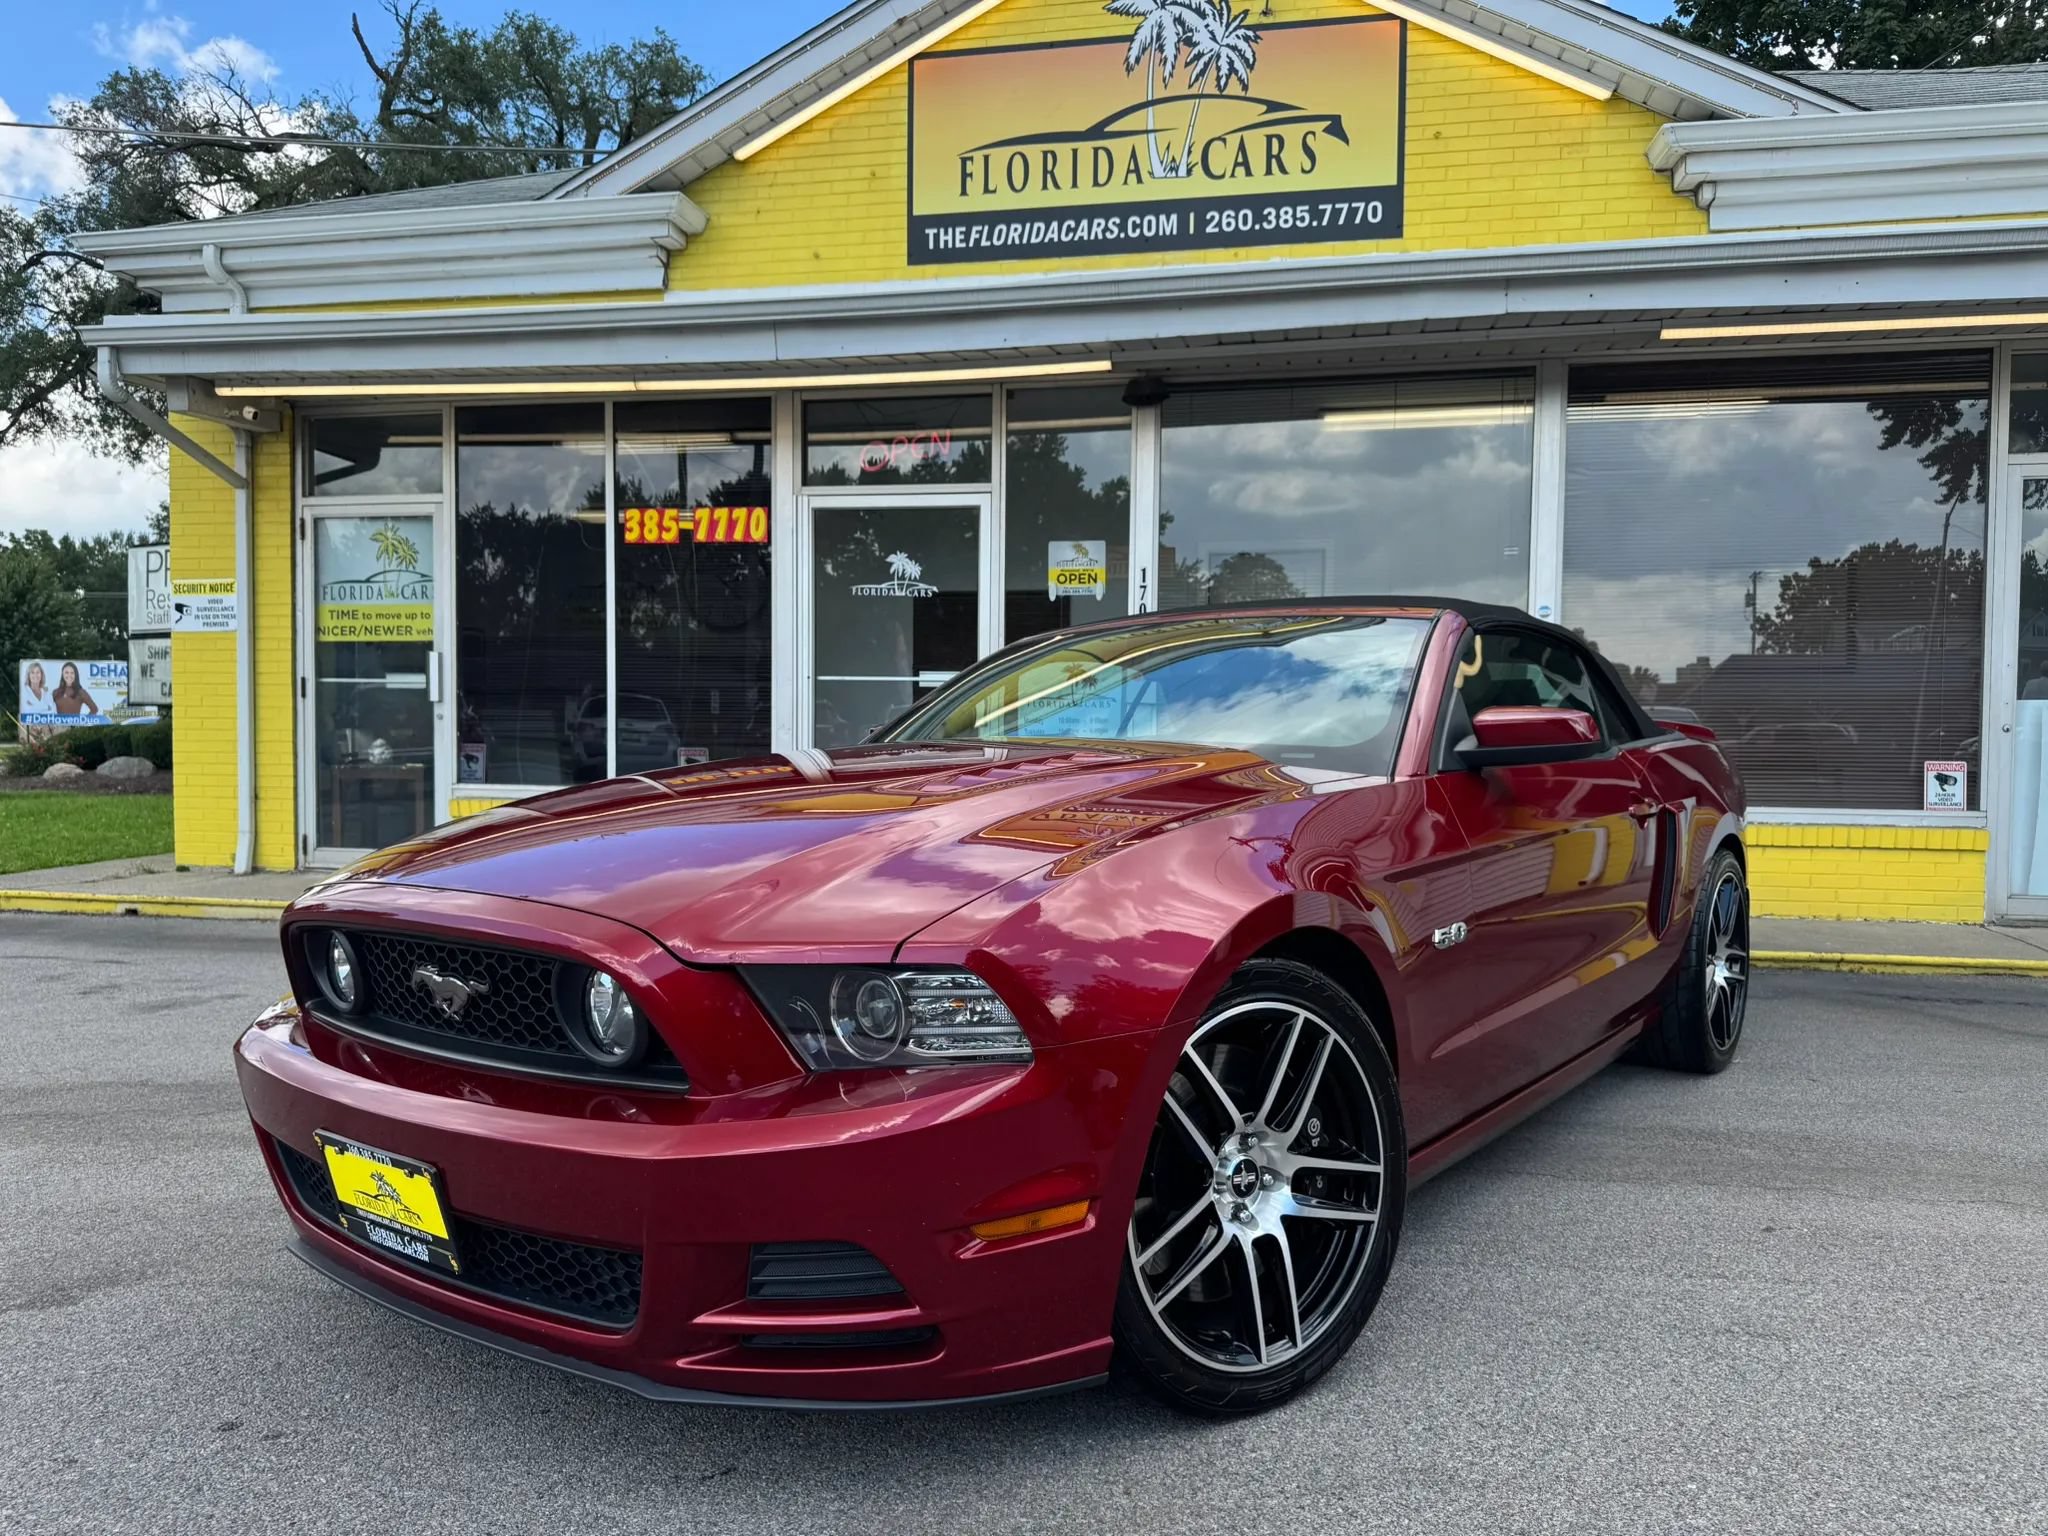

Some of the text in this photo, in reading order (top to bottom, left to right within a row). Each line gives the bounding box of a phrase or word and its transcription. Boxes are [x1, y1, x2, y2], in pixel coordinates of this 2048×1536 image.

[959, 130, 1318, 198] FLORIDA CARS
[925, 200, 1383, 251] THEFLORIDACARS.COM 260.385.7770
[861, 430, 952, 472] OPEN
[624, 506, 767, 543] 385-7770
[1057, 573, 1098, 584] OPEN
[173, 582, 234, 594] SECURITY NOTICE
[322, 584, 434, 600] FLORIDA CAR
[851, 586, 933, 598] FLORIDA CARS
[328, 609, 431, 622] TIME to move up to
[317, 625, 413, 637] NICER/NEWER
[141, 664, 154, 678] WE
[25, 713, 100, 725] #DeHavenDuo
